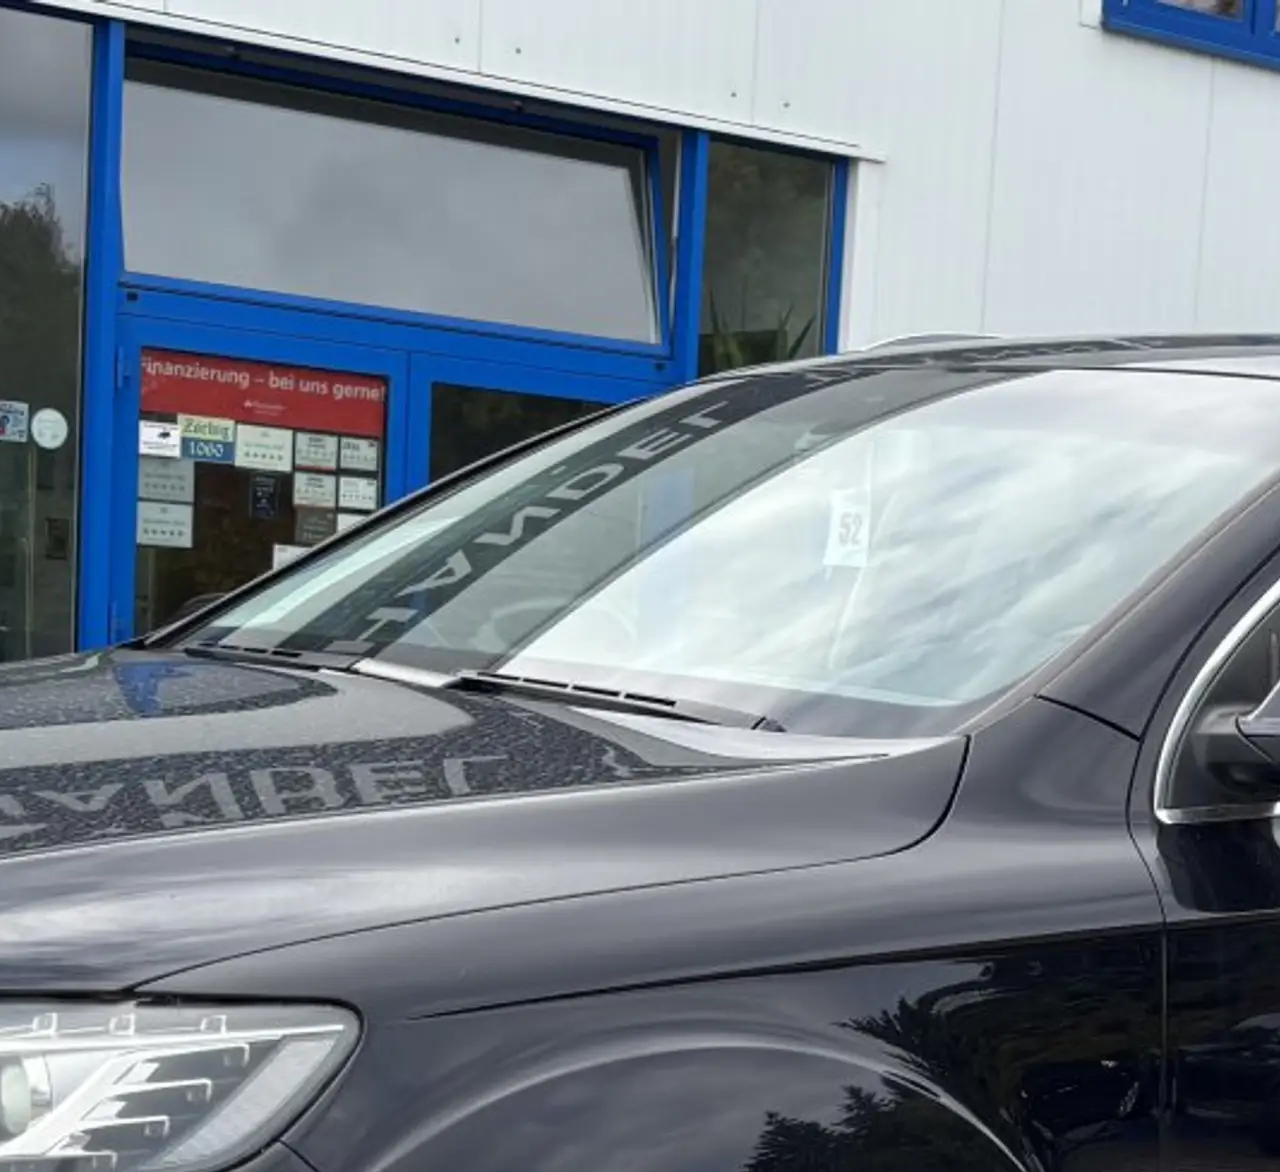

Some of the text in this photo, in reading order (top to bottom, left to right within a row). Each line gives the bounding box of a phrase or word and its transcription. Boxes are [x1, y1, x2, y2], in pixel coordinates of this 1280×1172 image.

[269, 370, 295, 391] bei
[299, 378, 328, 395] uns
[838, 511, 863, 547] 52
